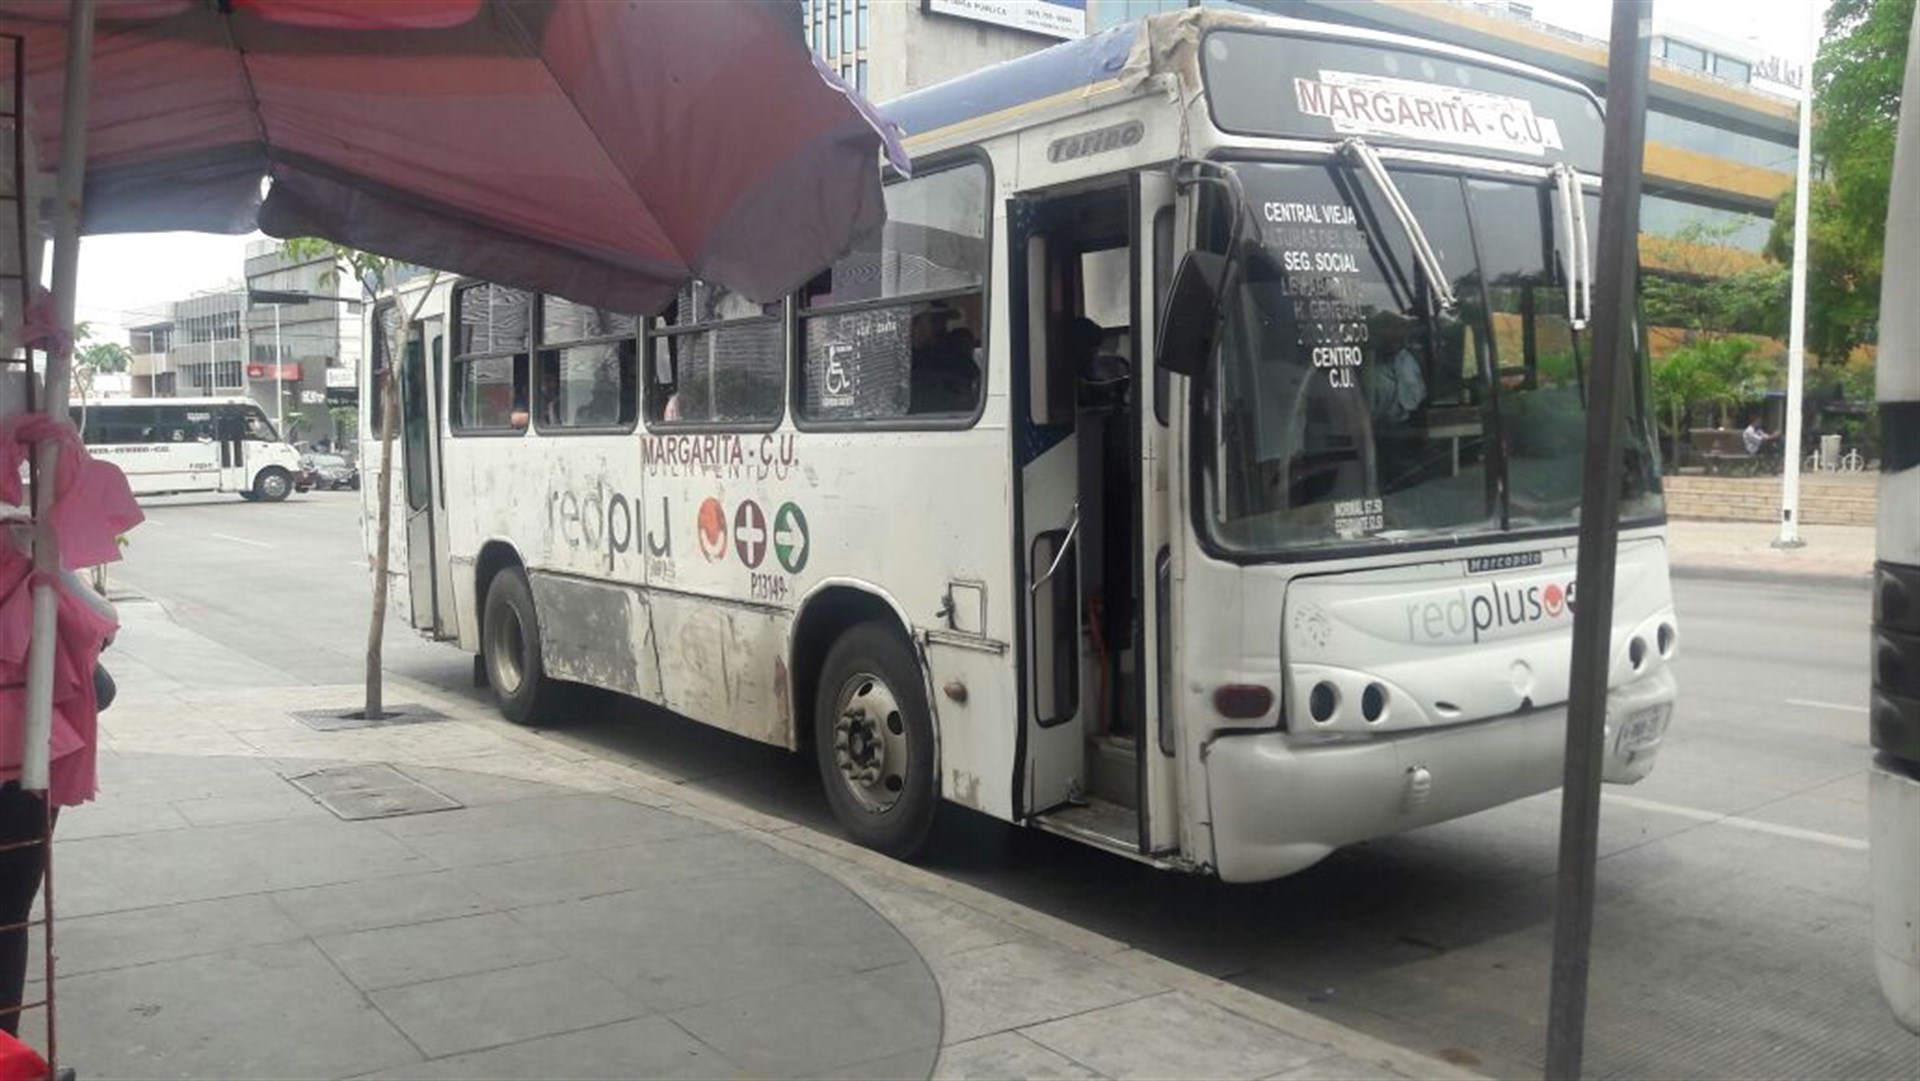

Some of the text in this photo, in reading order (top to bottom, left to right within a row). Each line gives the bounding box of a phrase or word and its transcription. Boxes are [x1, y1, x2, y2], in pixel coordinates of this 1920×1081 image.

[1299, 80, 1481, 135] MARGARITA
[1500, 112, 1552, 145] C.U.
[1264, 202, 1357, 225] CENTRAL VIEJA
[1284, 251, 1360, 273] SEG. SOCIAL
[1312, 346, 1362, 368] CENTRO
[1329, 368, 1354, 388] C.U.
[642, 434, 743, 466] MARGARITA
[760, 434, 799, 467] C.U.
[1470, 552, 1541, 572] Marcopolo
[1405, 580, 1542, 644] redplus
